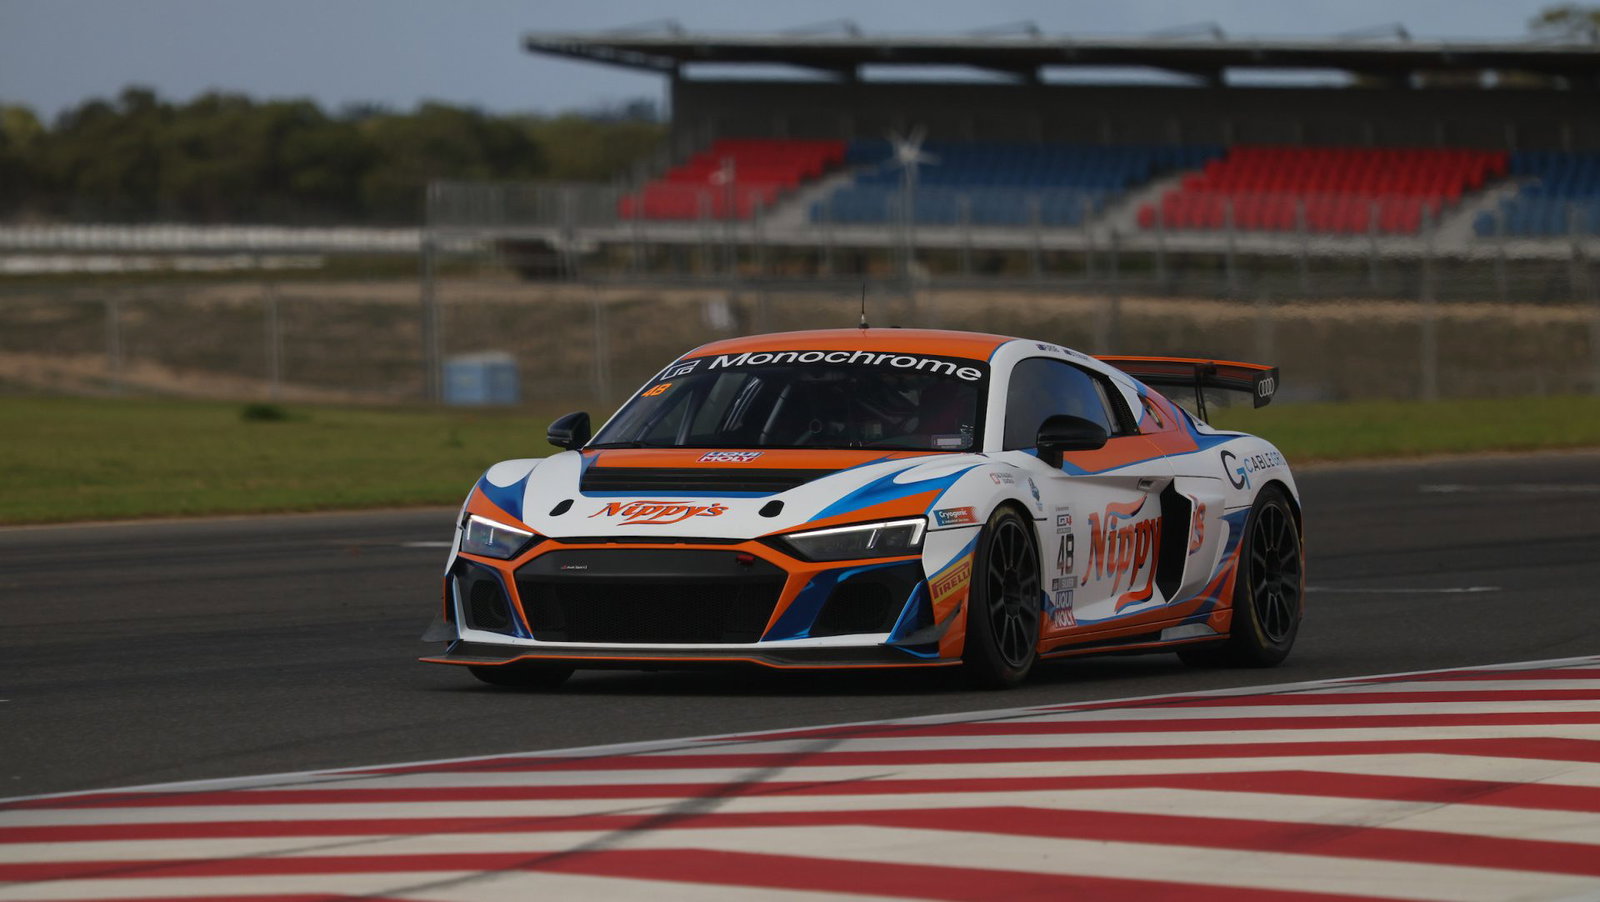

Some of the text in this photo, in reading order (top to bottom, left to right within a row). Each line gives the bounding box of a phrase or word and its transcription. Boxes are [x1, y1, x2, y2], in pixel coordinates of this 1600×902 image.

[708, 351, 982, 381] Monochrome
[641, 383, 672, 397] 48
[587, 501, 729, 526] Nippy's
[938, 509, 968, 519] Cryogenic
[1056, 534, 1074, 576] 48
[931, 561, 971, 599] PIRELLI
[1056, 590, 1074, 609] LIQUI
[1055, 608, 1076, 628] MOLY
